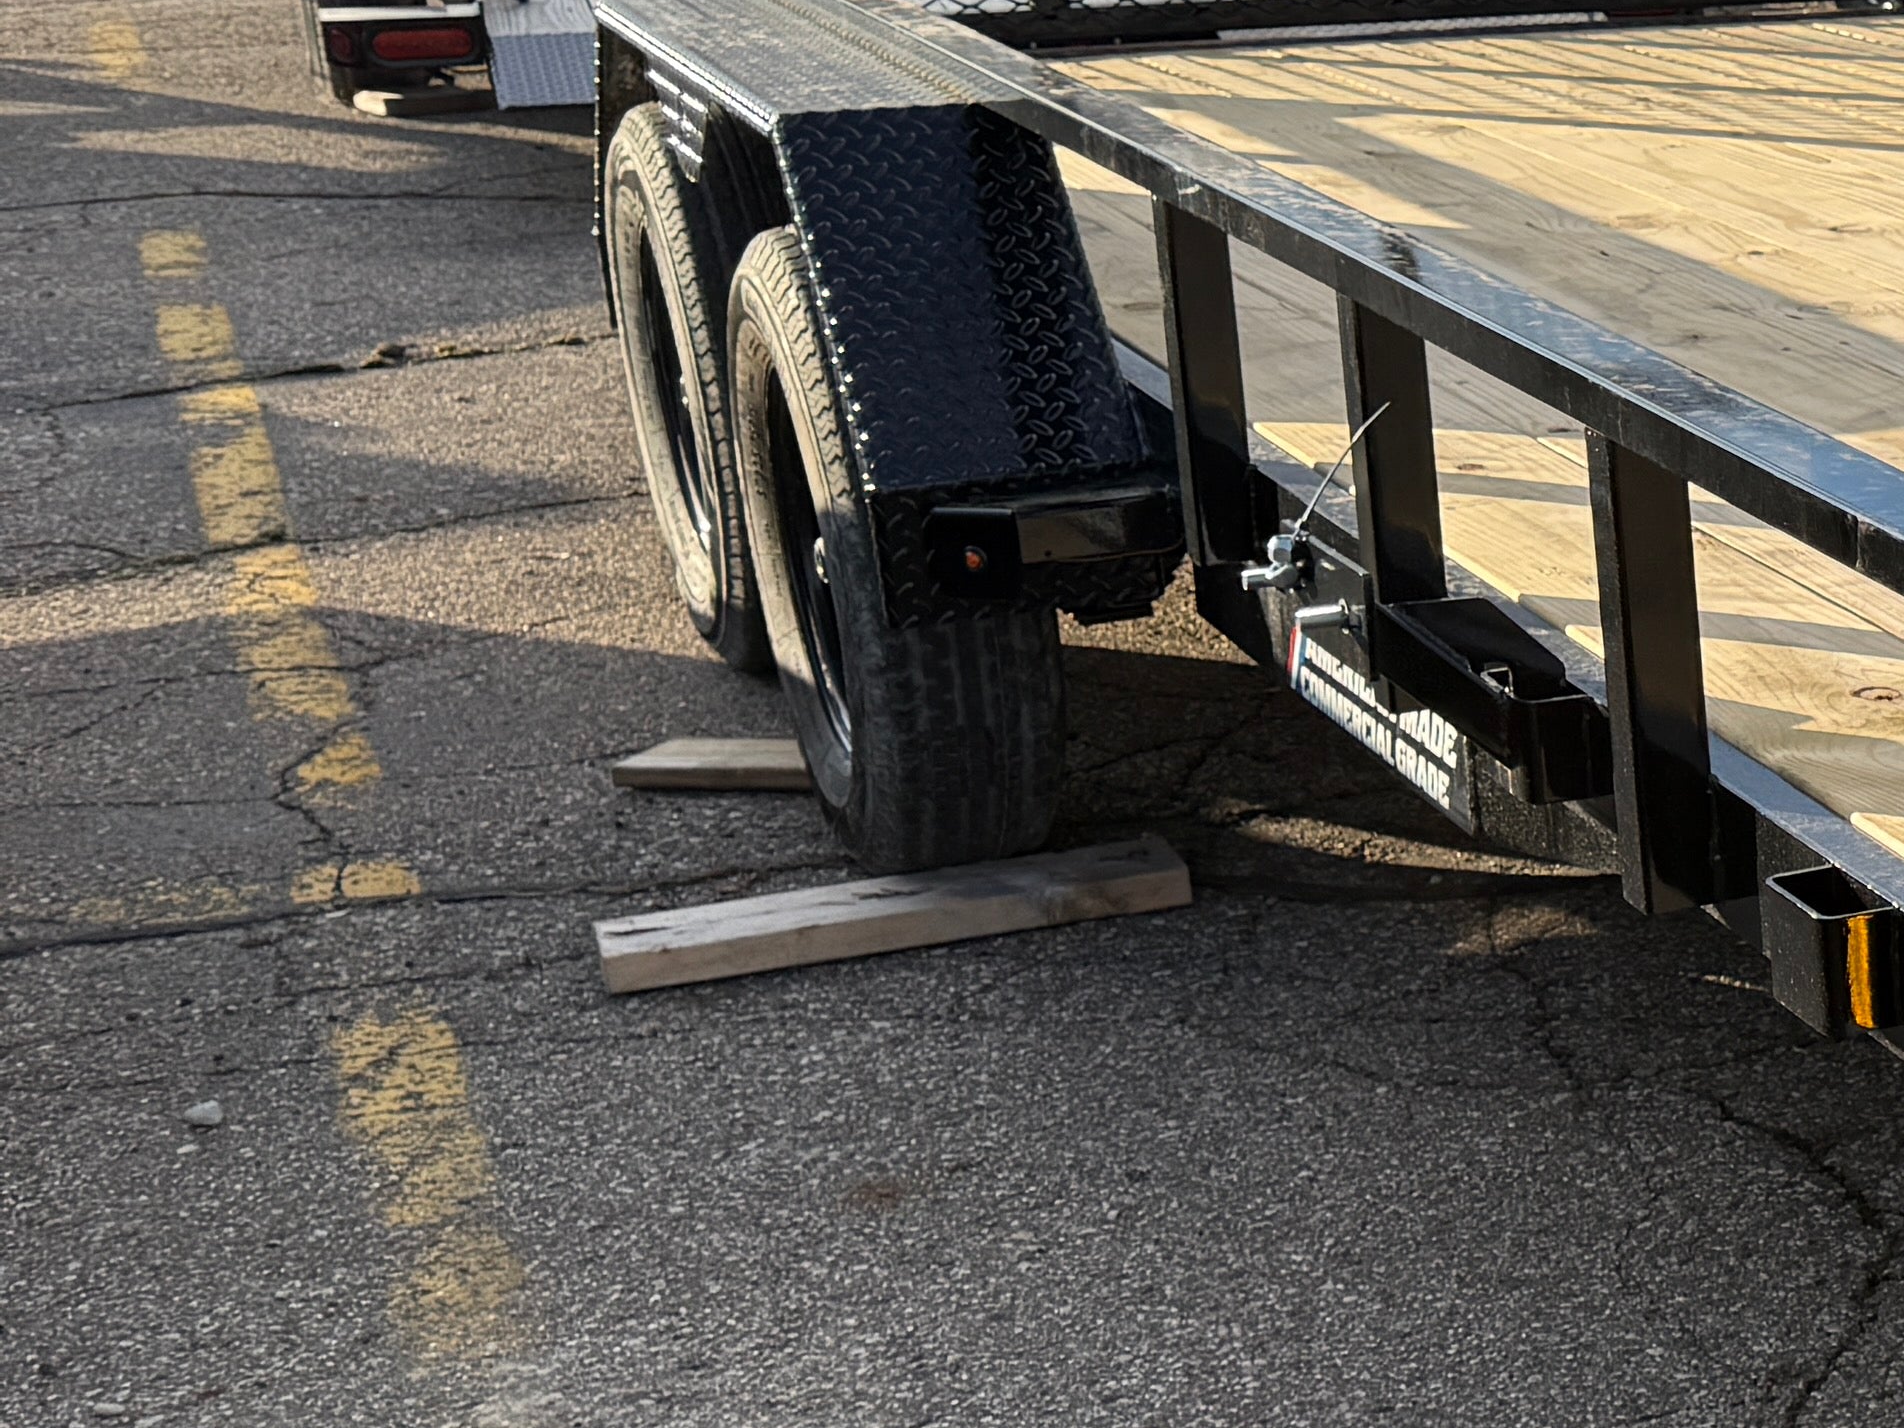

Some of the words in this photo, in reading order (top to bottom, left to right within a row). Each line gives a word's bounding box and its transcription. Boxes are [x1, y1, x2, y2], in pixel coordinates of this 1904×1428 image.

[1299, 665, 1395, 769] COMMERCIAL
[1395, 736, 1451, 811] GRADE
[1399, 708, 1459, 769] MADE
